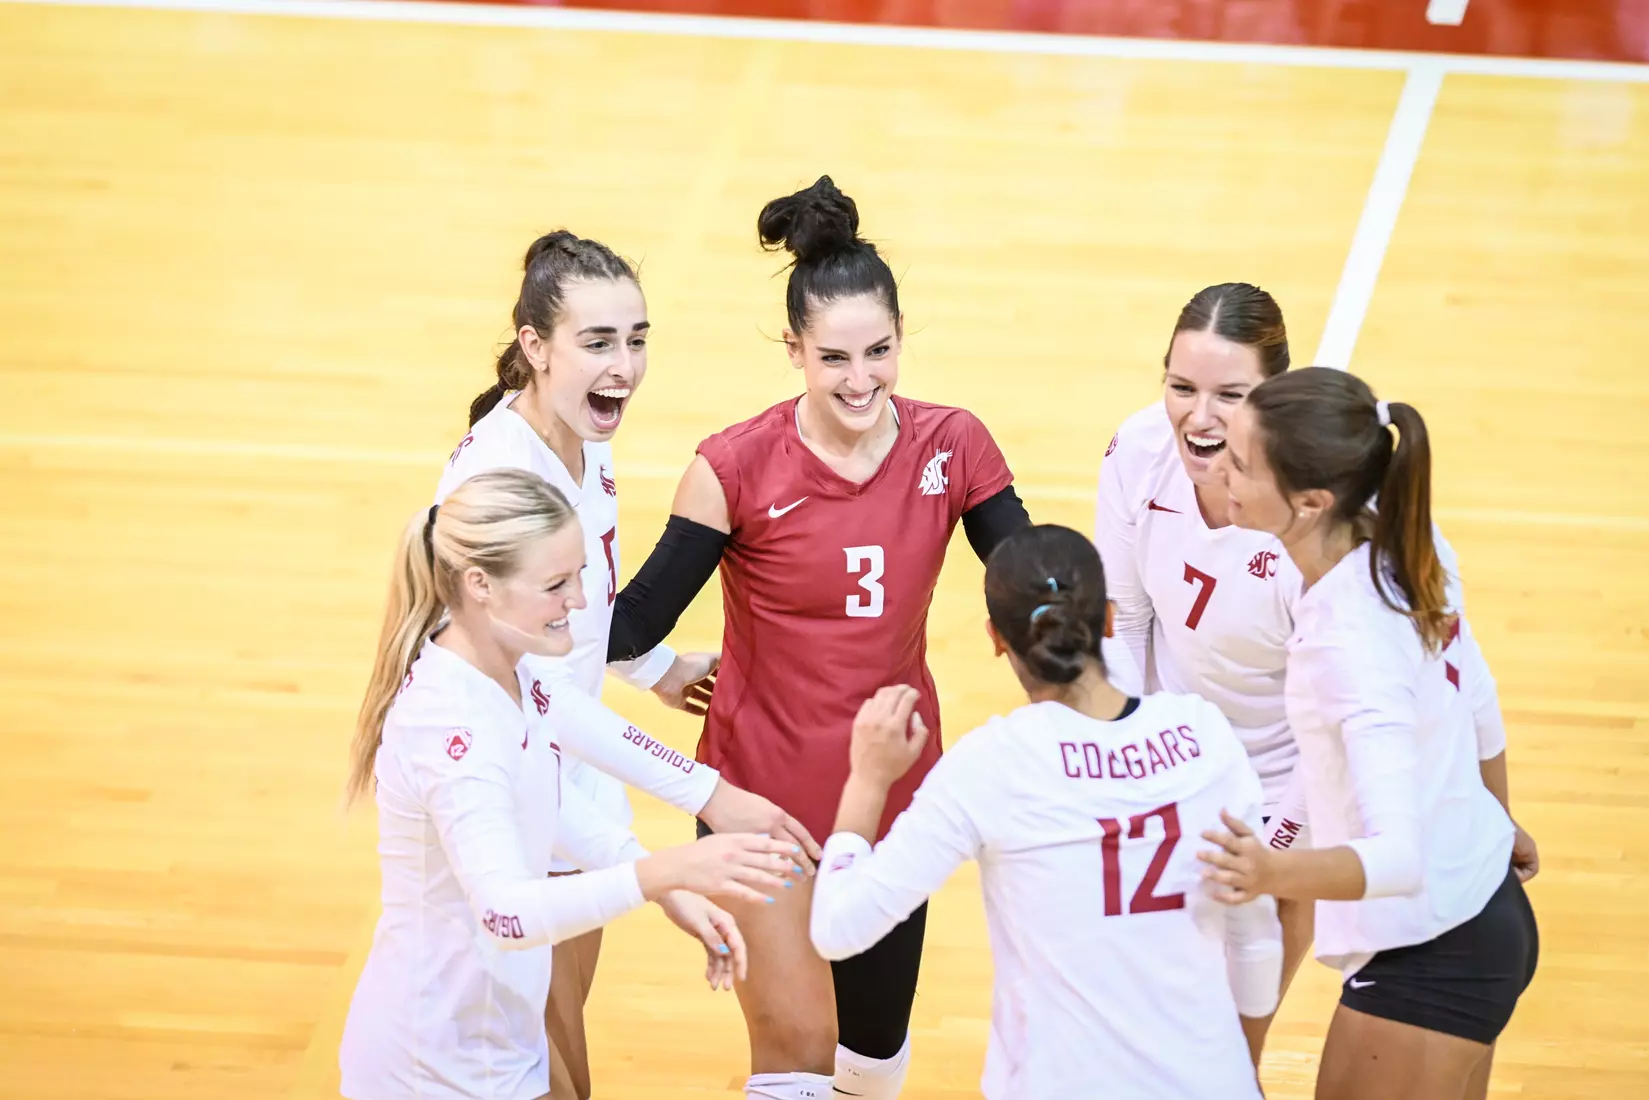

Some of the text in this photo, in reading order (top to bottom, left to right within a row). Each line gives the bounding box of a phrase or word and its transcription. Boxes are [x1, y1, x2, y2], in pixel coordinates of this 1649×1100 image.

[842, 545, 885, 618] 3
[1183, 559, 1218, 631] 7
[622, 725, 696, 774] COUGARS
[1096, 802, 1186, 917] 12
